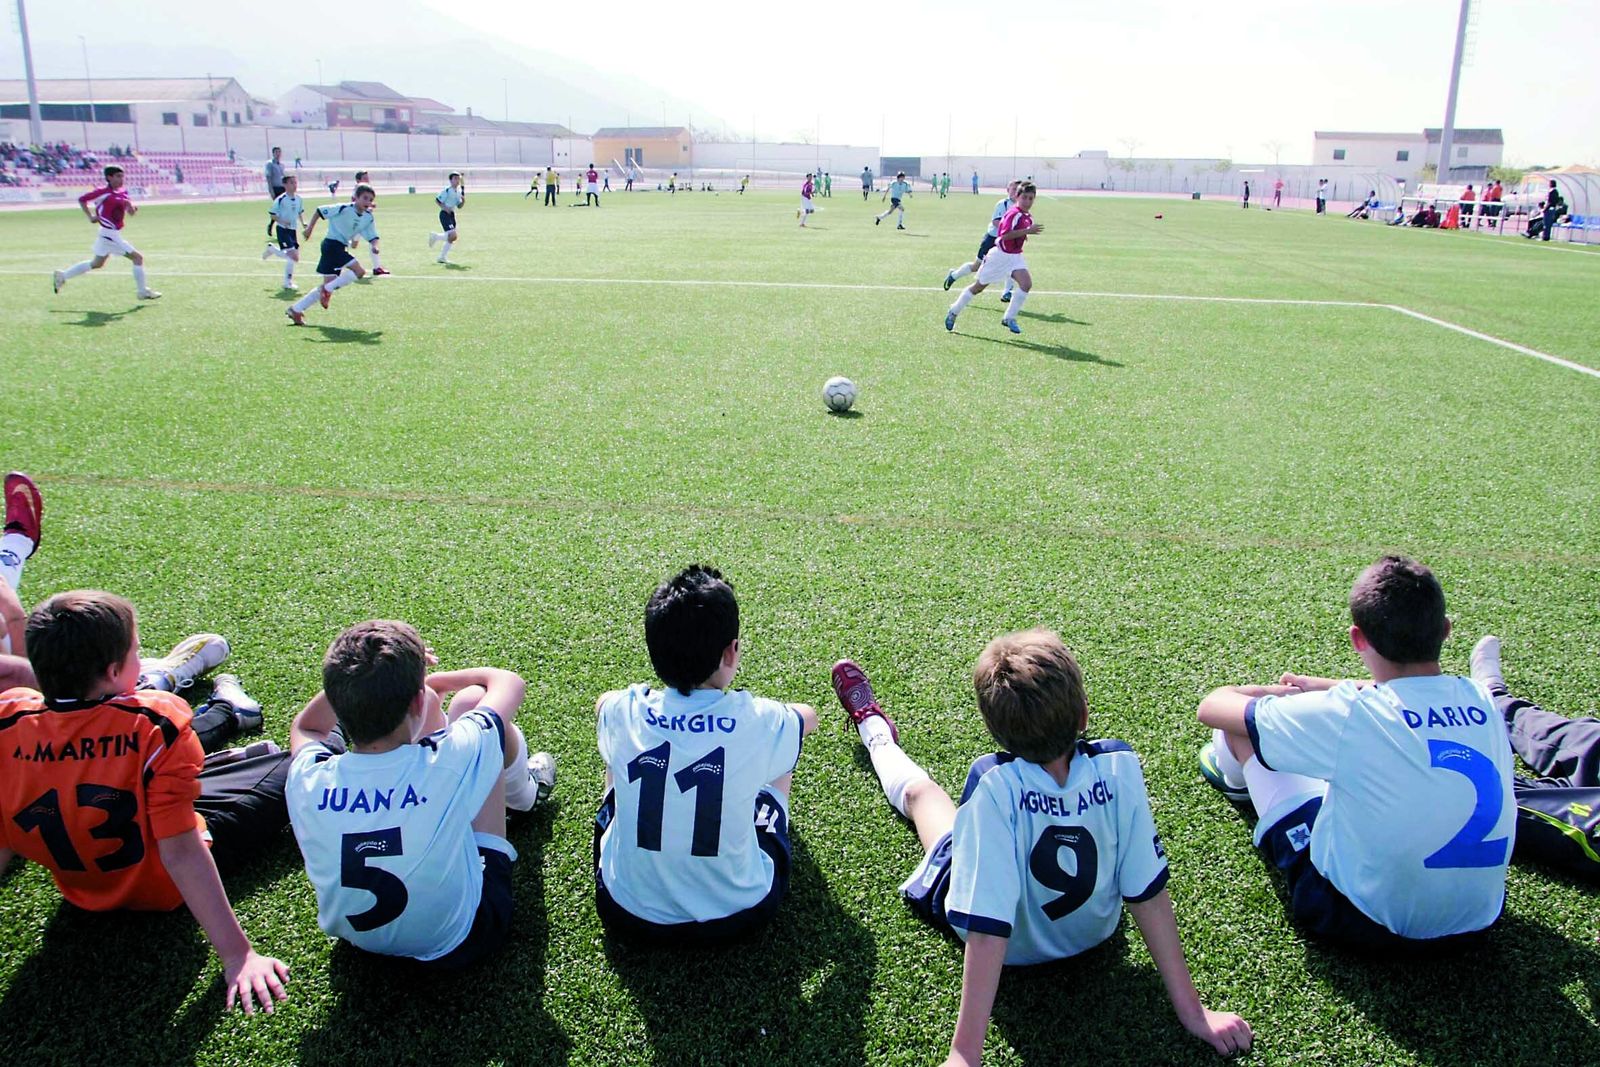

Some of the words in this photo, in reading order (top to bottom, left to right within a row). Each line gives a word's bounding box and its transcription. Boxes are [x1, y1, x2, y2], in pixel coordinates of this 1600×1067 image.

[645, 707, 737, 733] SERGIO
[1402, 706, 1488, 729] DARIO
[12, 783, 145, 873] 13
[317, 787, 395, 814] JUAN
[400, 783, 428, 809] A.
[627, 740, 725, 857] 11
[1423, 739, 1509, 869] 2
[341, 826, 409, 932] 5
[1029, 825, 1098, 922] 9
